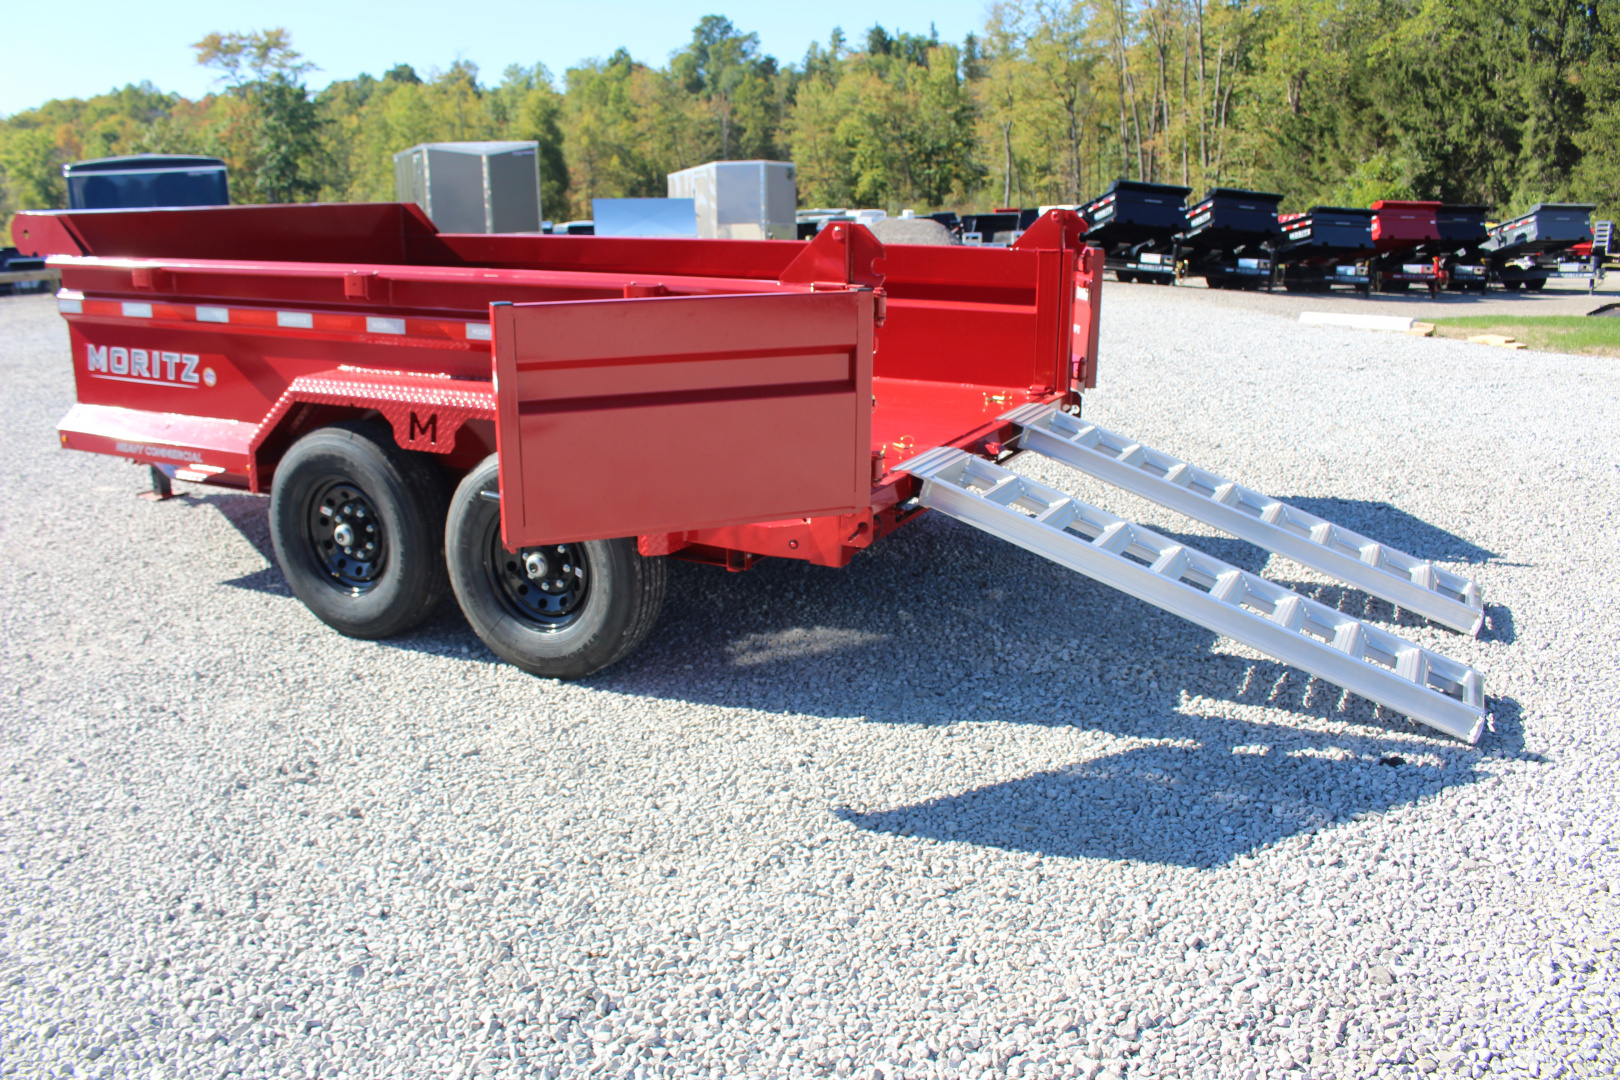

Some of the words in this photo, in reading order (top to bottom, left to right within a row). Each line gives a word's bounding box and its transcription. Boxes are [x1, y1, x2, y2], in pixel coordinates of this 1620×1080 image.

[472, 328, 491, 336] MOR
[87, 344, 199, 383] MORITZ
[409, 411, 437, 444] M
[116, 442, 144, 455] HEAVY
[144, 446, 203, 463] COMMERCIAL
